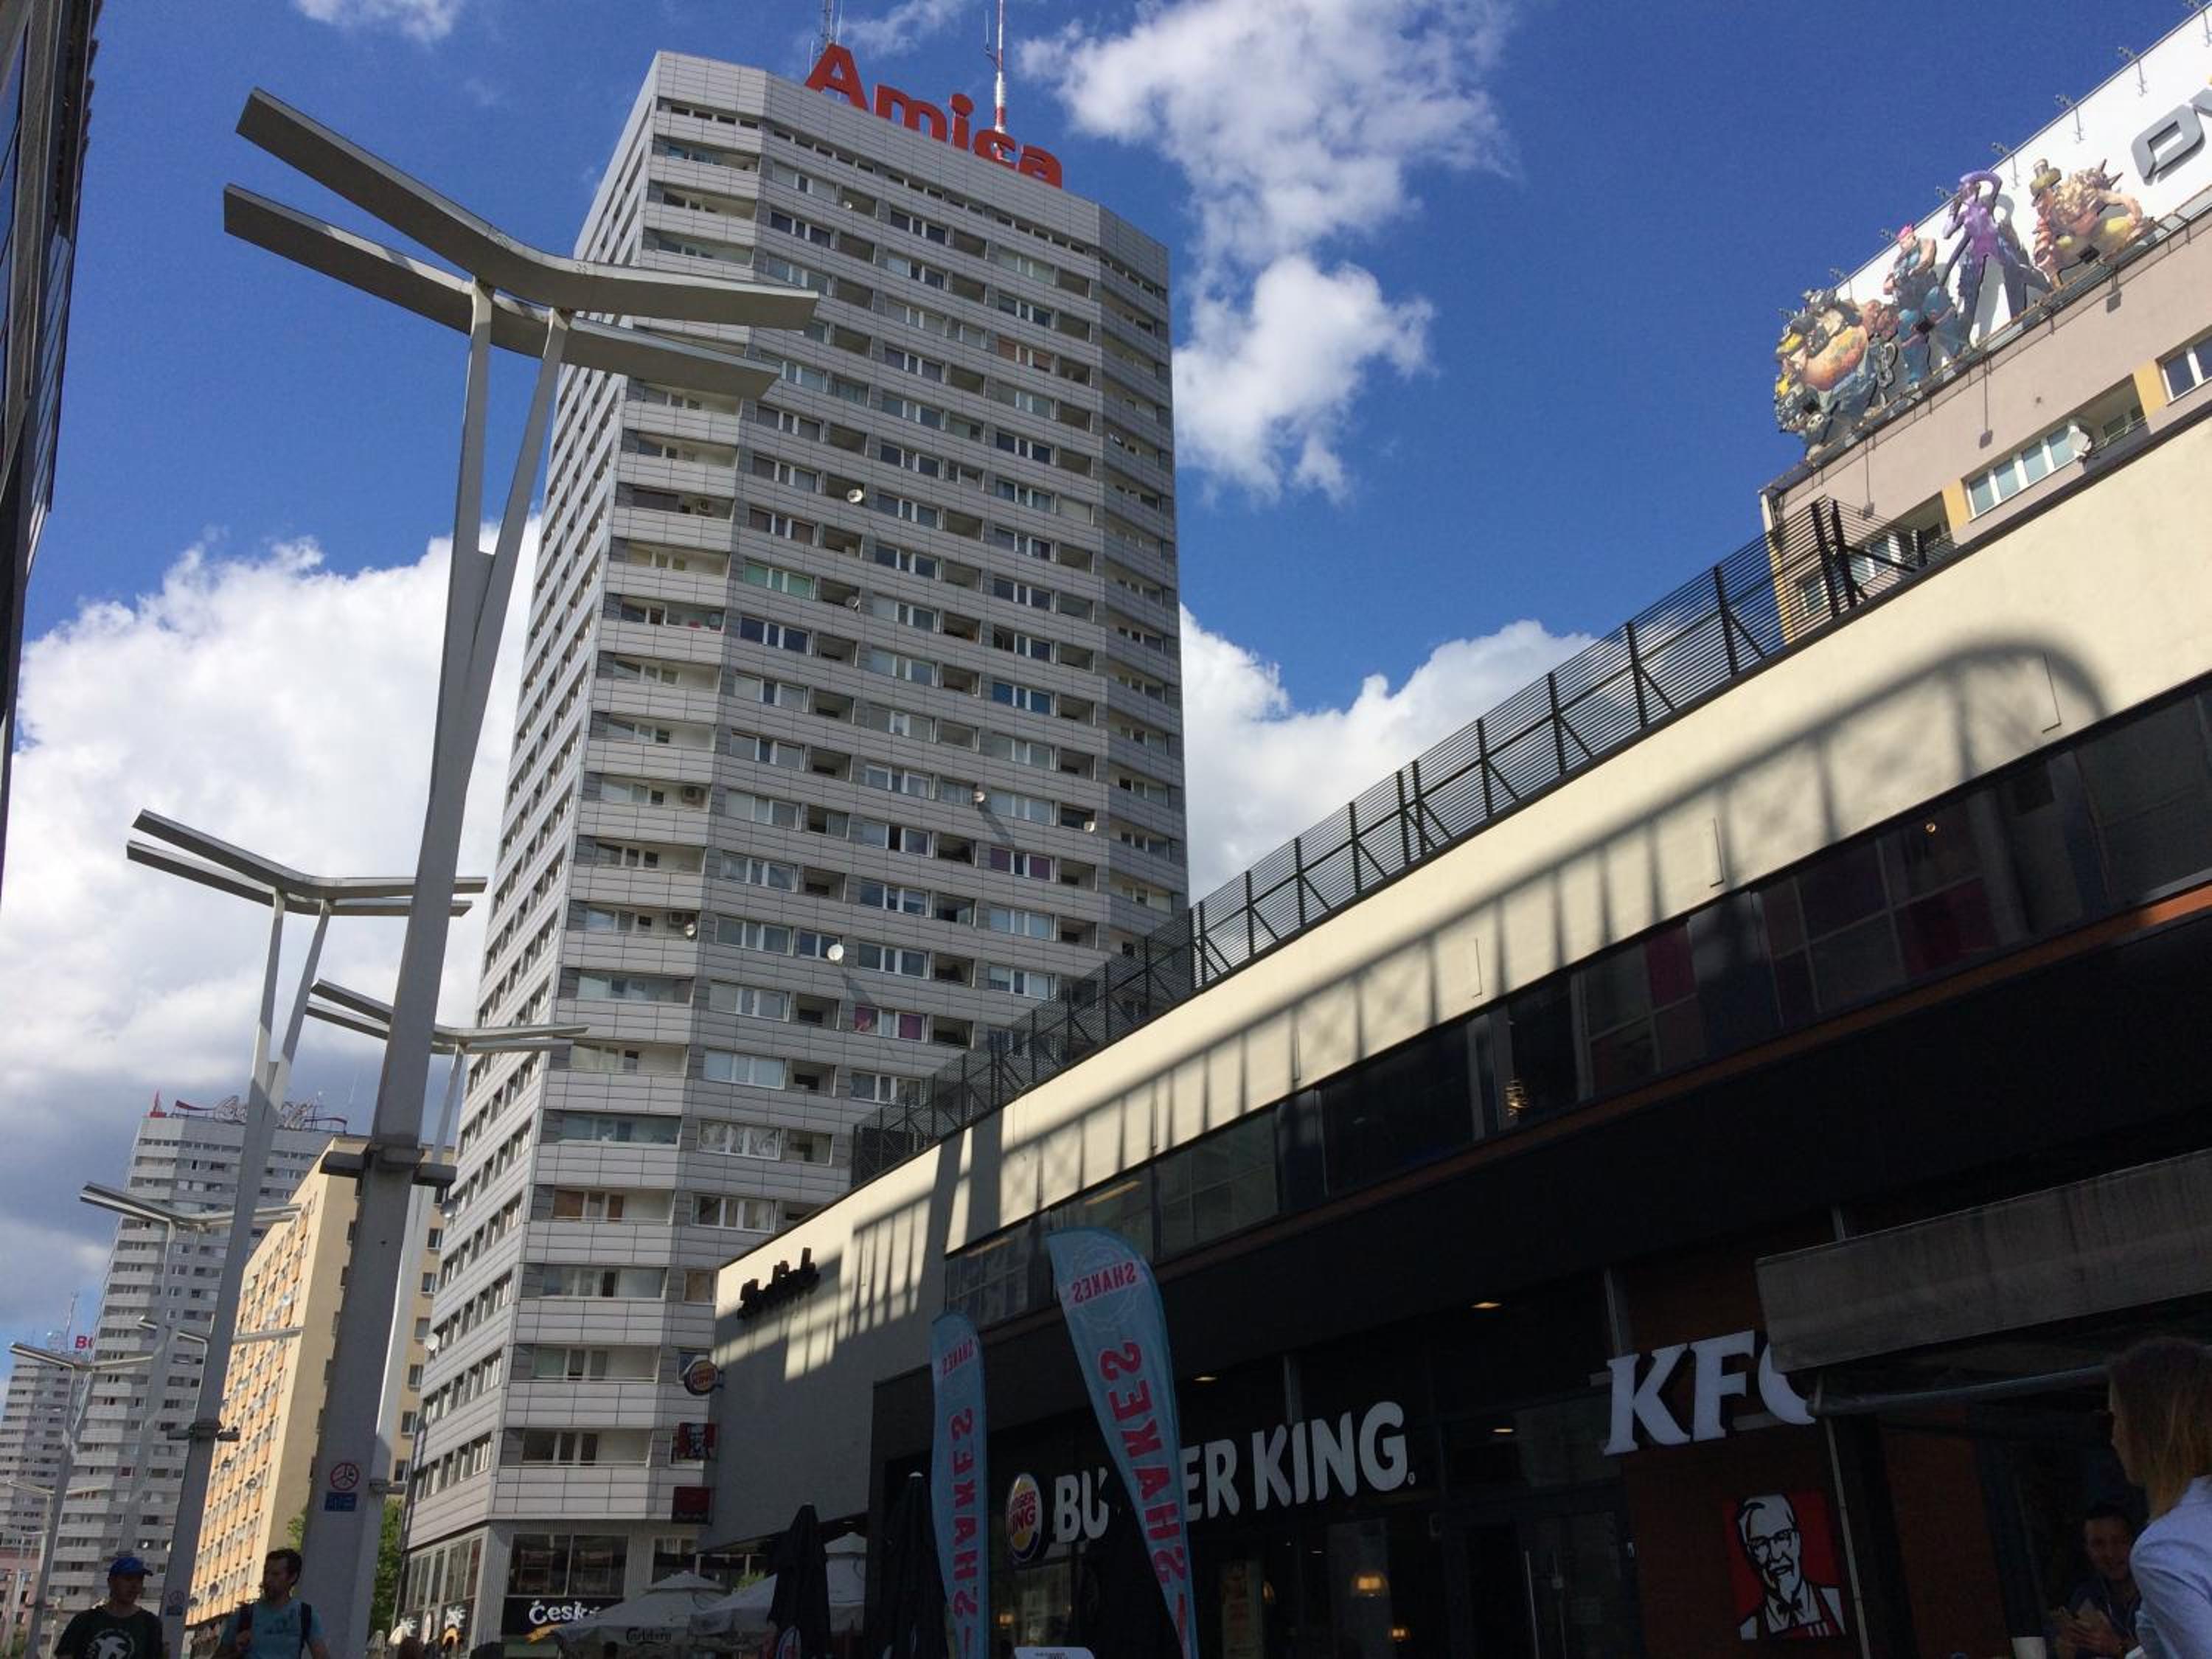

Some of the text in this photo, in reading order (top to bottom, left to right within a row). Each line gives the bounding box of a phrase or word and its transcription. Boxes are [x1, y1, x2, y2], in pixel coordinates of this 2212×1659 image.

[805, 44, 1062, 188] Amica
[1055, 1401, 1408, 1544] BUER KING
